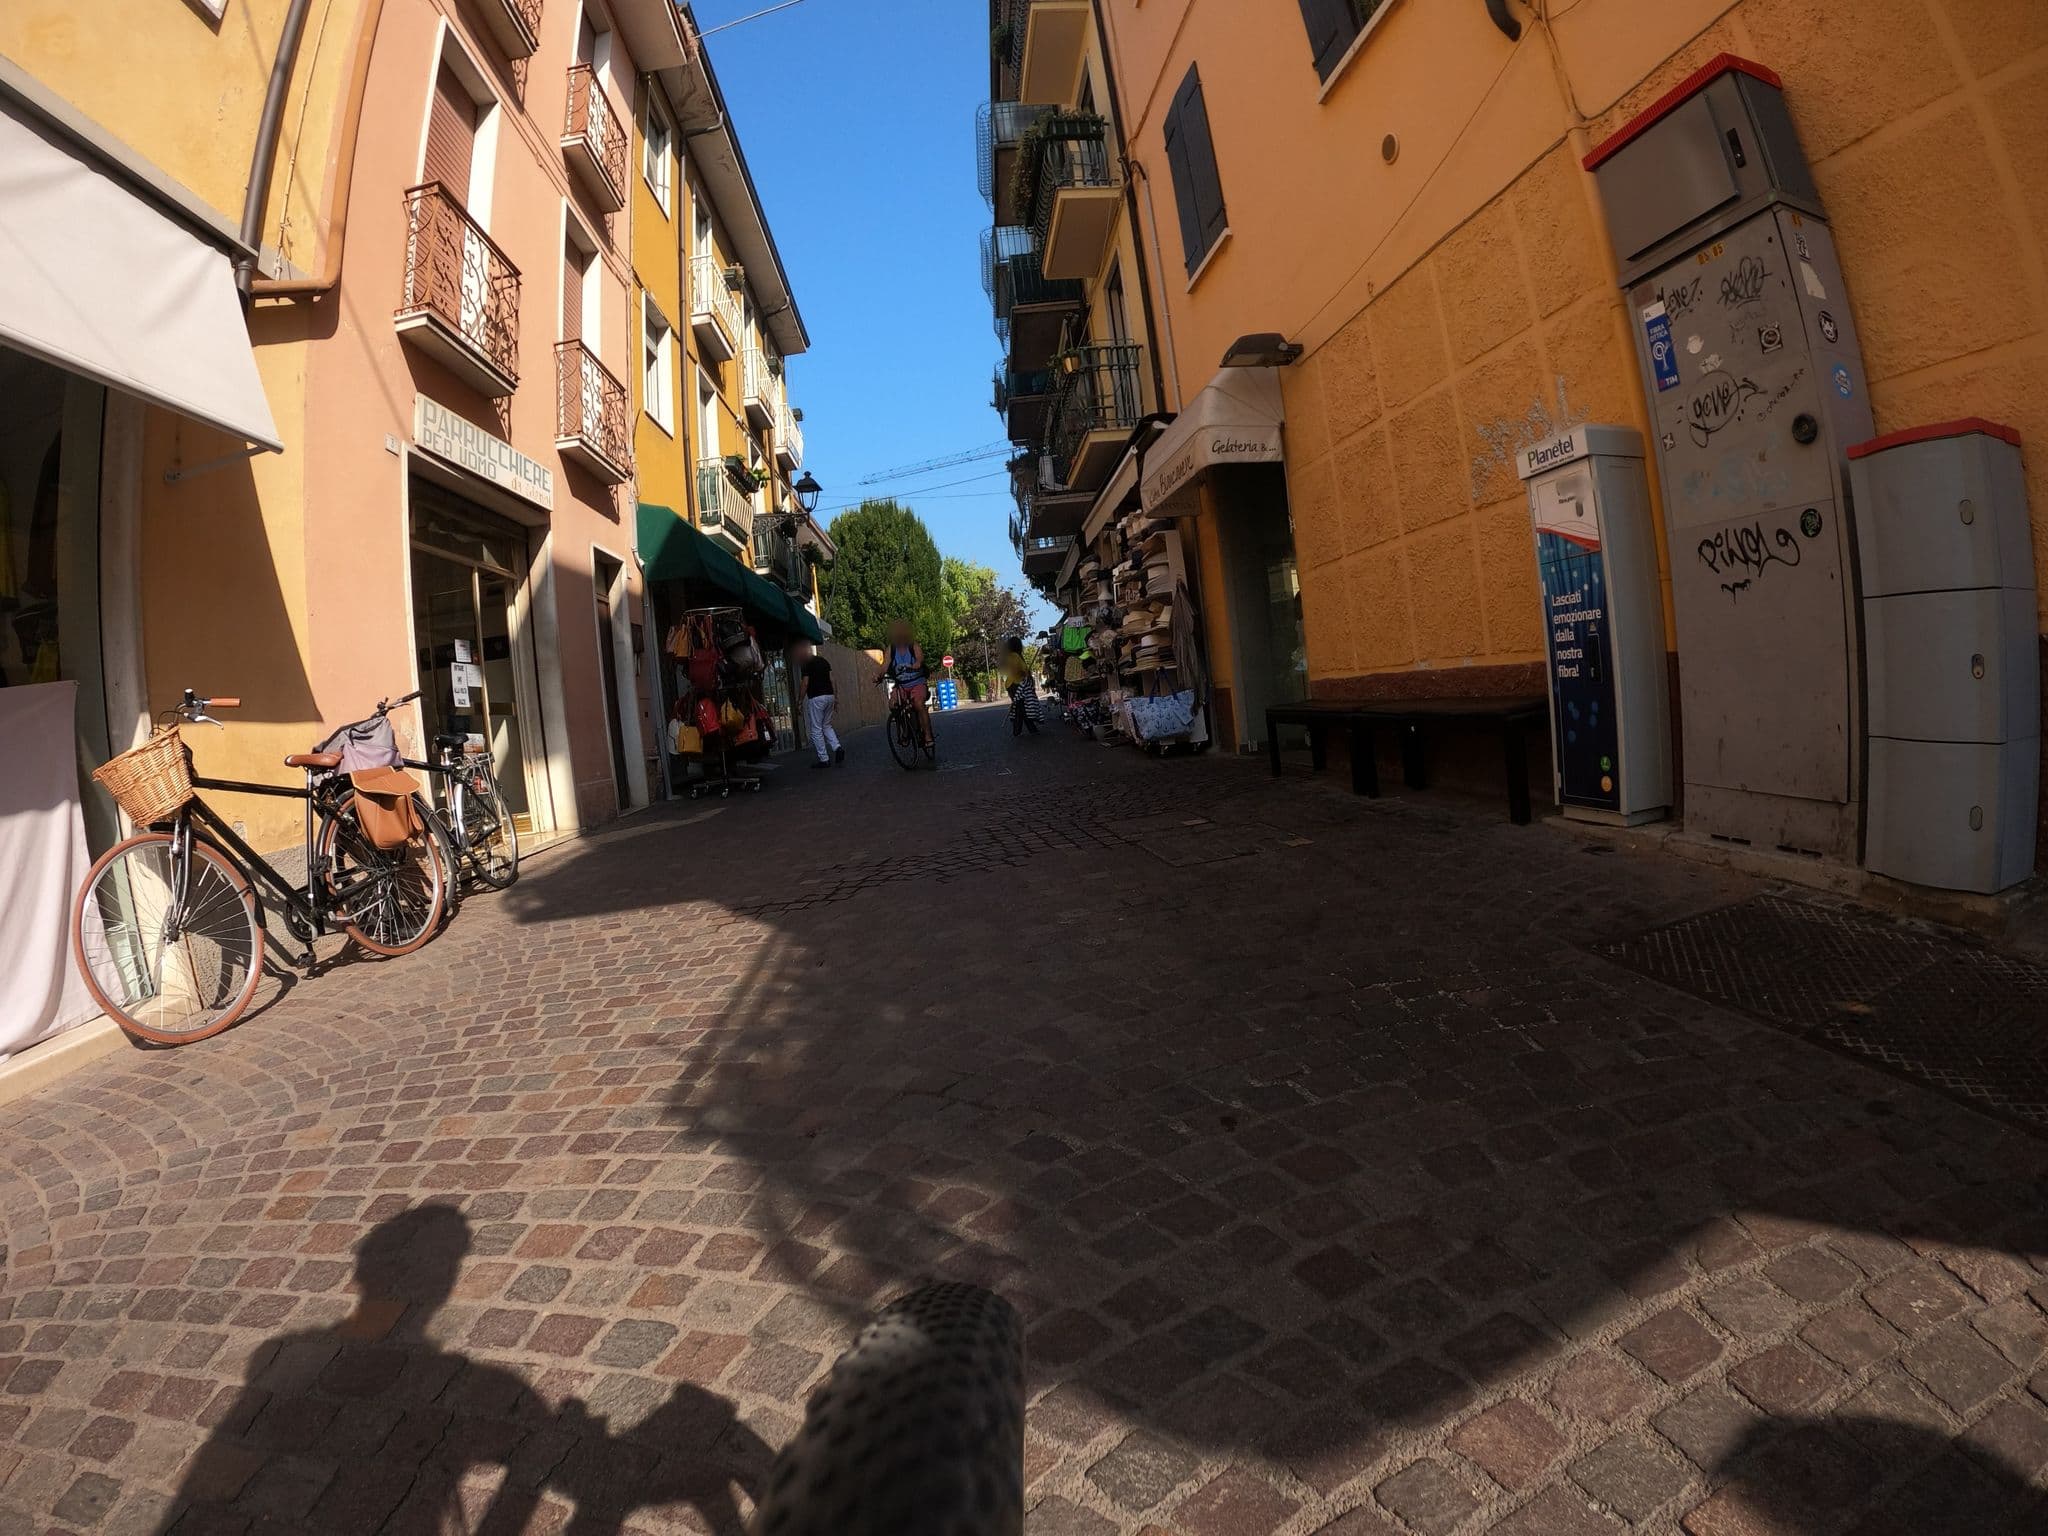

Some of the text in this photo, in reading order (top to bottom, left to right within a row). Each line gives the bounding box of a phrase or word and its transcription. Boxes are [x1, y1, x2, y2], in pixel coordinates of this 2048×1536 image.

[1665, 374, 1678, 386] TIM
[423, 400, 550, 492] PARRUCCHIERE
[423, 427, 497, 480] PER UOMO
[1212, 438, 1257, 454] Gelateria
[1527, 434, 1574, 469] Planetel
[1551, 590, 1582, 606] Lasciati
[1553, 609, 1602, 624] emozionare
[1555, 628, 1575, 642] dalla
[1557, 648, 1583, 660] nostra
[1558, 664, 1580, 678] fibra!
